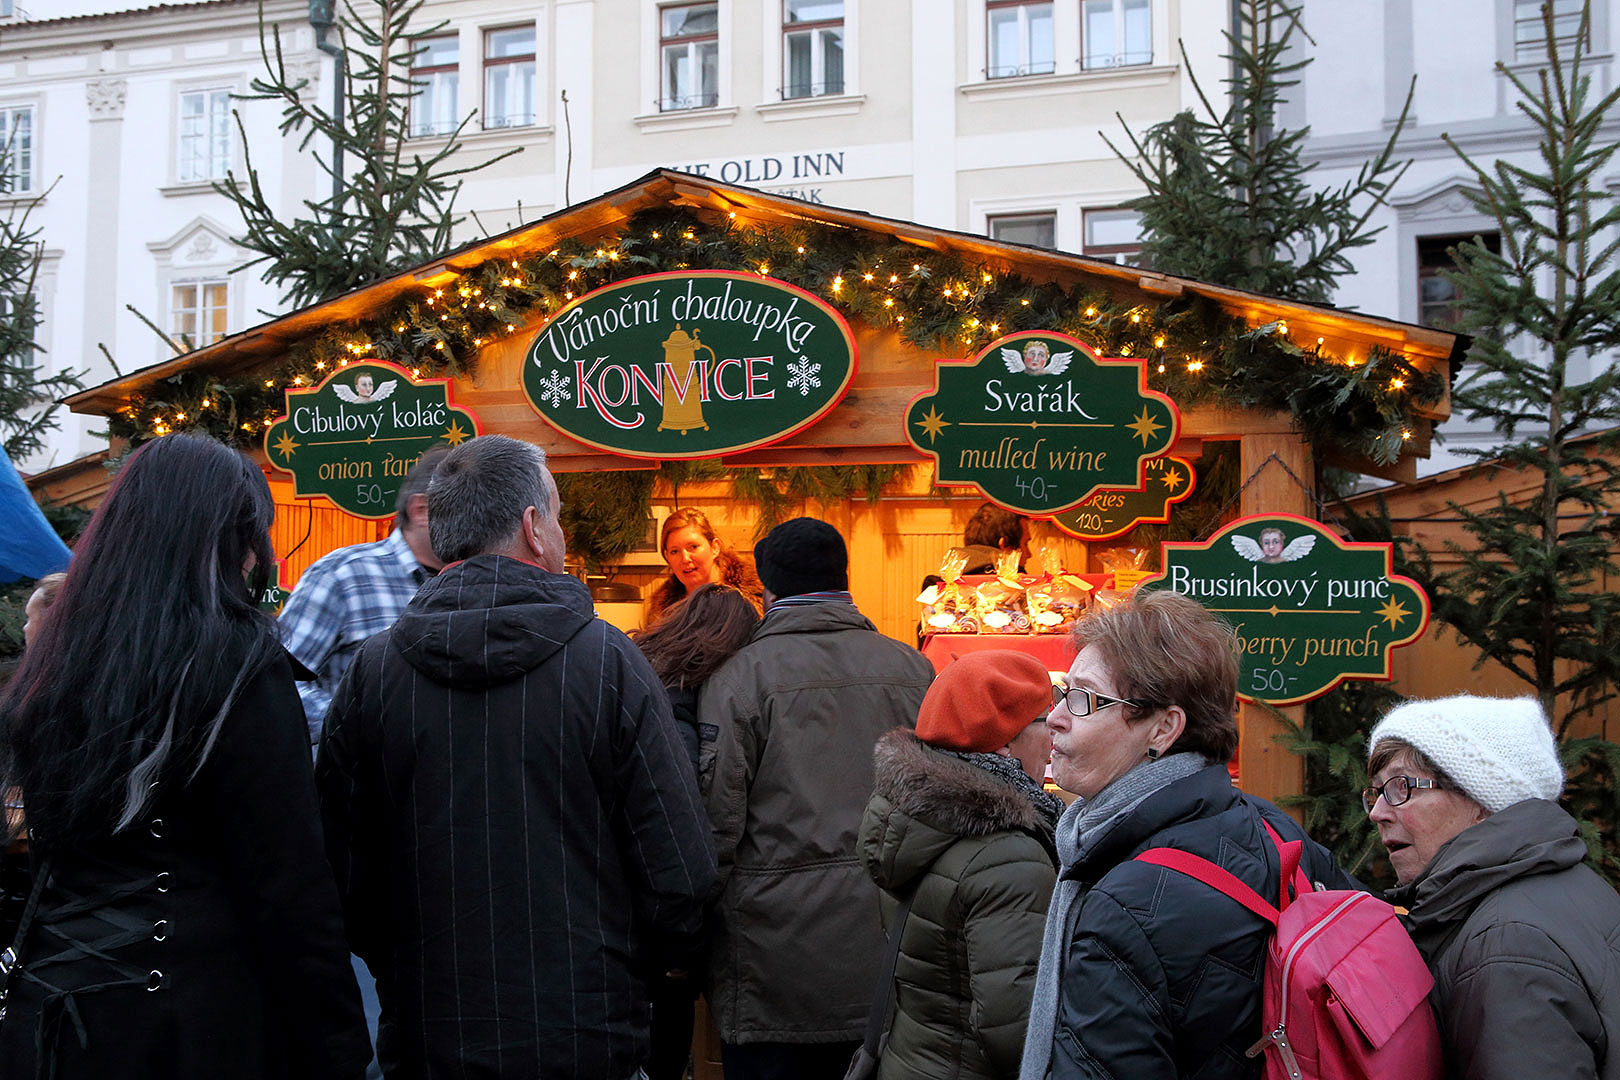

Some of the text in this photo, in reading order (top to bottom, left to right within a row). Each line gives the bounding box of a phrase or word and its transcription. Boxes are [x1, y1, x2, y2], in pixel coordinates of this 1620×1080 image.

[720, 157, 783, 184] OLD
[792, 151, 845, 179] INN
[532, 279, 817, 368] Vánoční chaloupka
[573, 354, 777, 431] KONVICE
[983, 379, 1099, 420] Svařák
[292, 399, 447, 438] Cibulový koláč
[318, 456, 374, 481] onion
[958, 436, 1108, 472] mulled wine
[1169, 564, 1319, 607] Brusinkový
[1327, 576, 1390, 608] punč
[1295, 624, 1380, 667] punch
